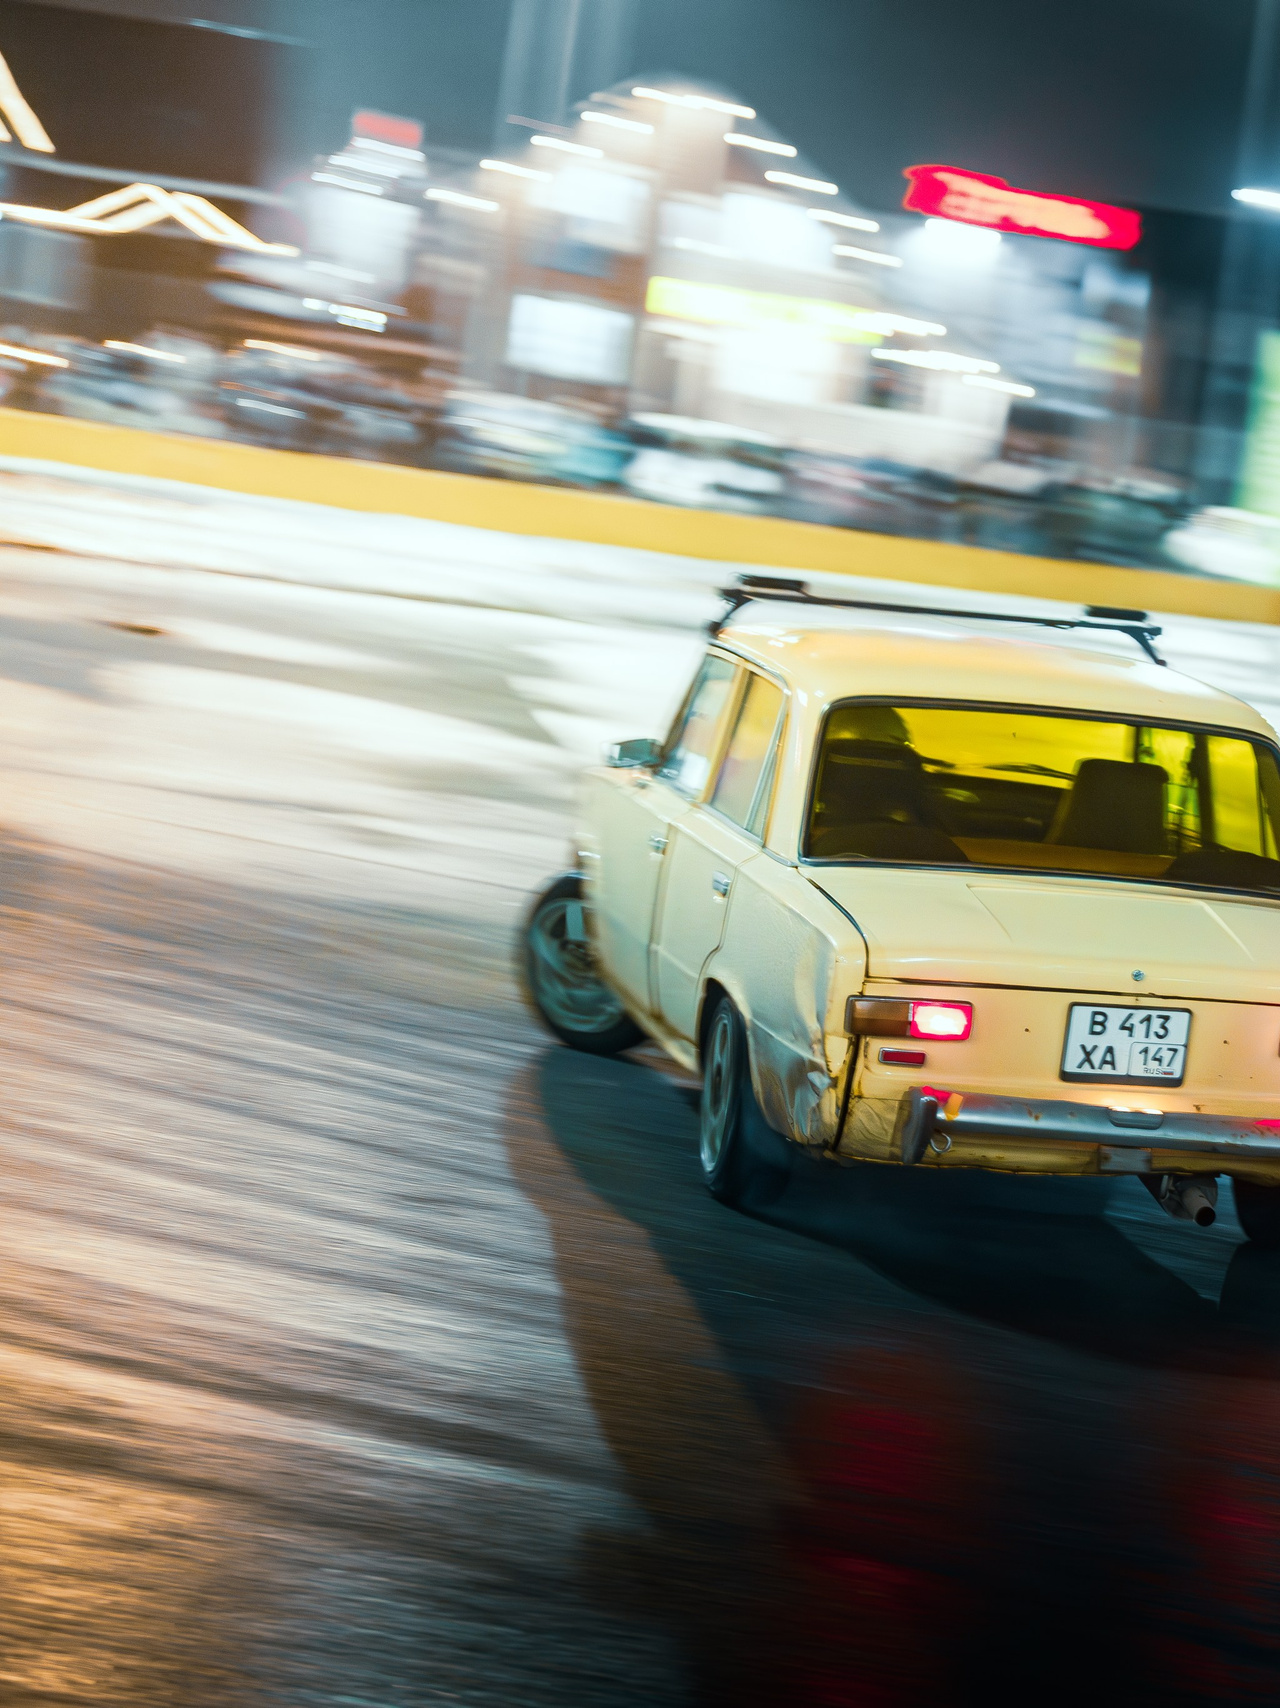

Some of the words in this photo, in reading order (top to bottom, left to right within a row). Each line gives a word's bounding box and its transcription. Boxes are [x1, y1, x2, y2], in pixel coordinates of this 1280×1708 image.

[1118, 1012, 1171, 1040] 413
[1138, 1046, 1179, 1067] 147
[1143, 1067, 1161, 1075] RUS
